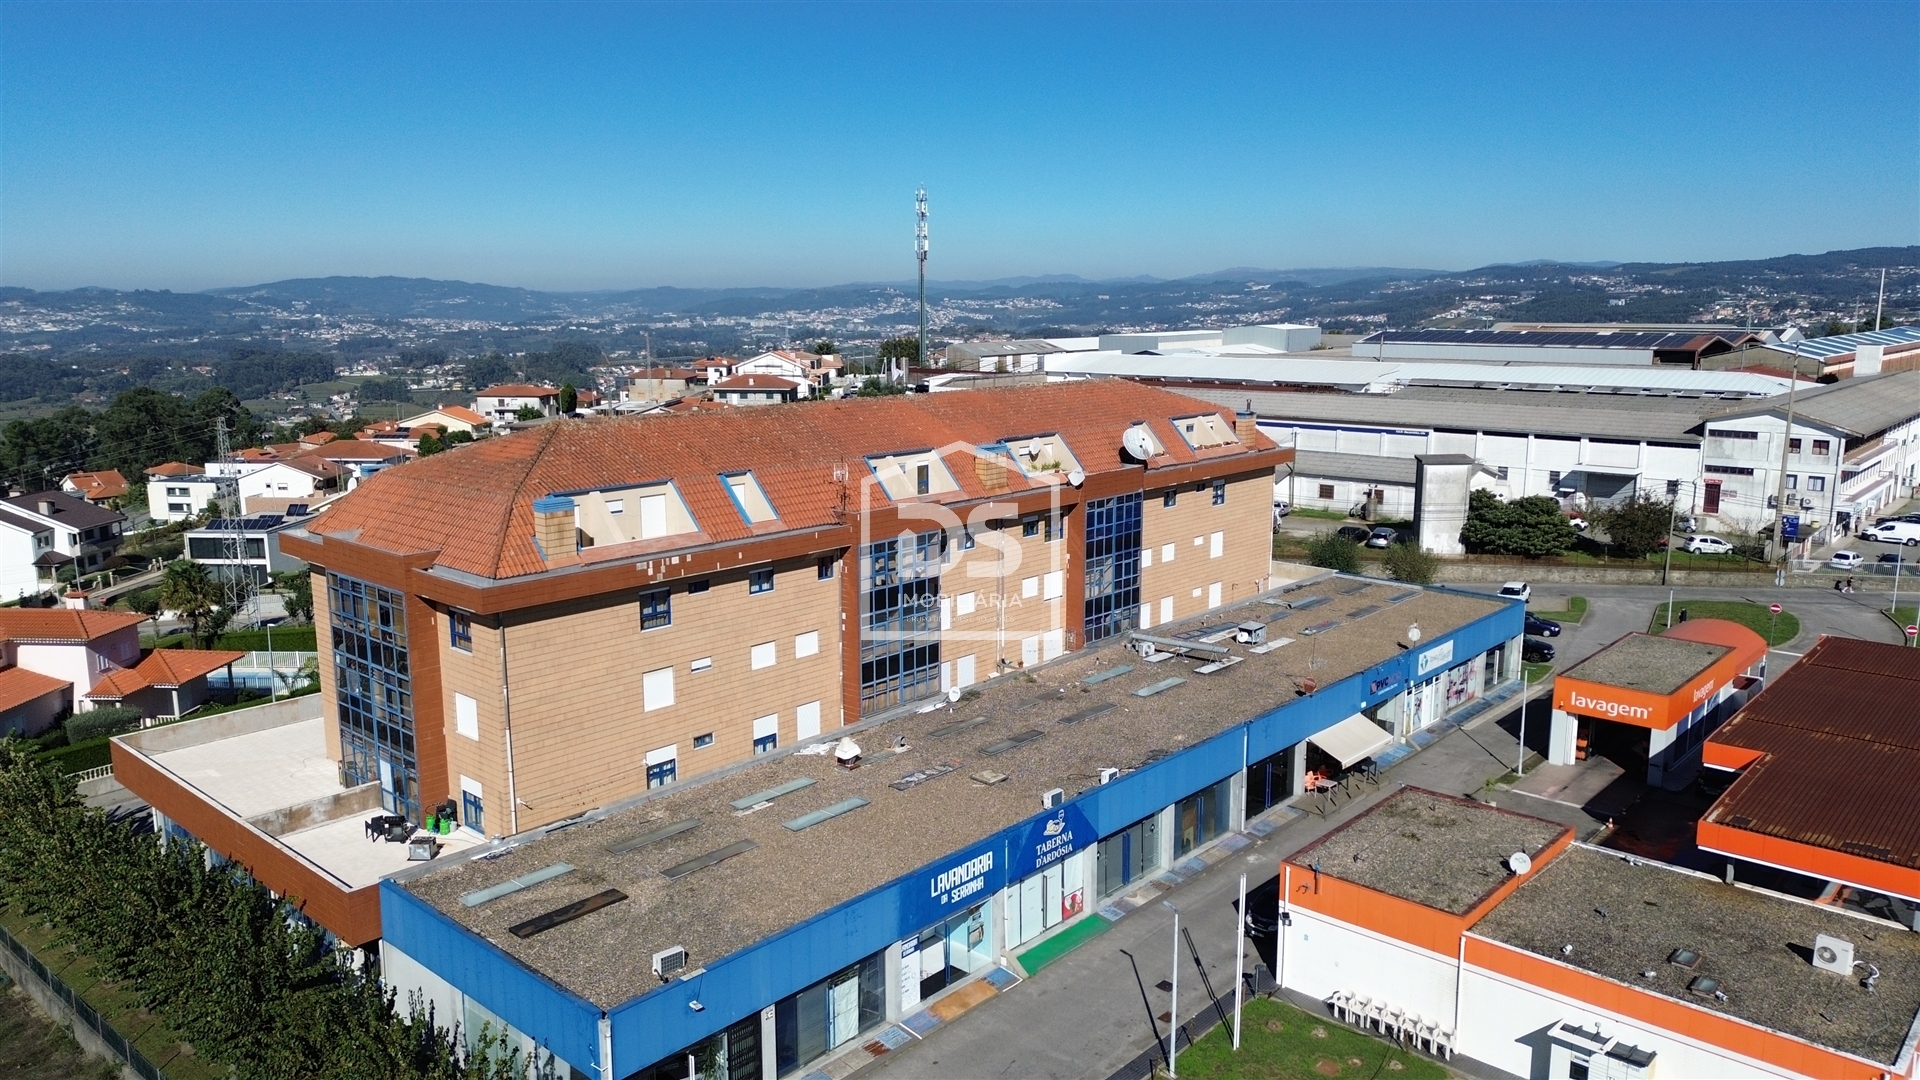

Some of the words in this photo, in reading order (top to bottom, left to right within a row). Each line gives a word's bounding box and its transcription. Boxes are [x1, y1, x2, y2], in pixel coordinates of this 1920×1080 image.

[1693, 679, 1714, 703] lavagem
[1571, 691, 1648, 719] lavagem
[1036, 830, 1073, 856] TABERNA
[1036, 843, 1073, 868] D'ARDÓSIA
[931, 851, 993, 898] LAVANDARIA
[941, 893, 949, 905] DA
[951, 876, 984, 903] SERRINHA
